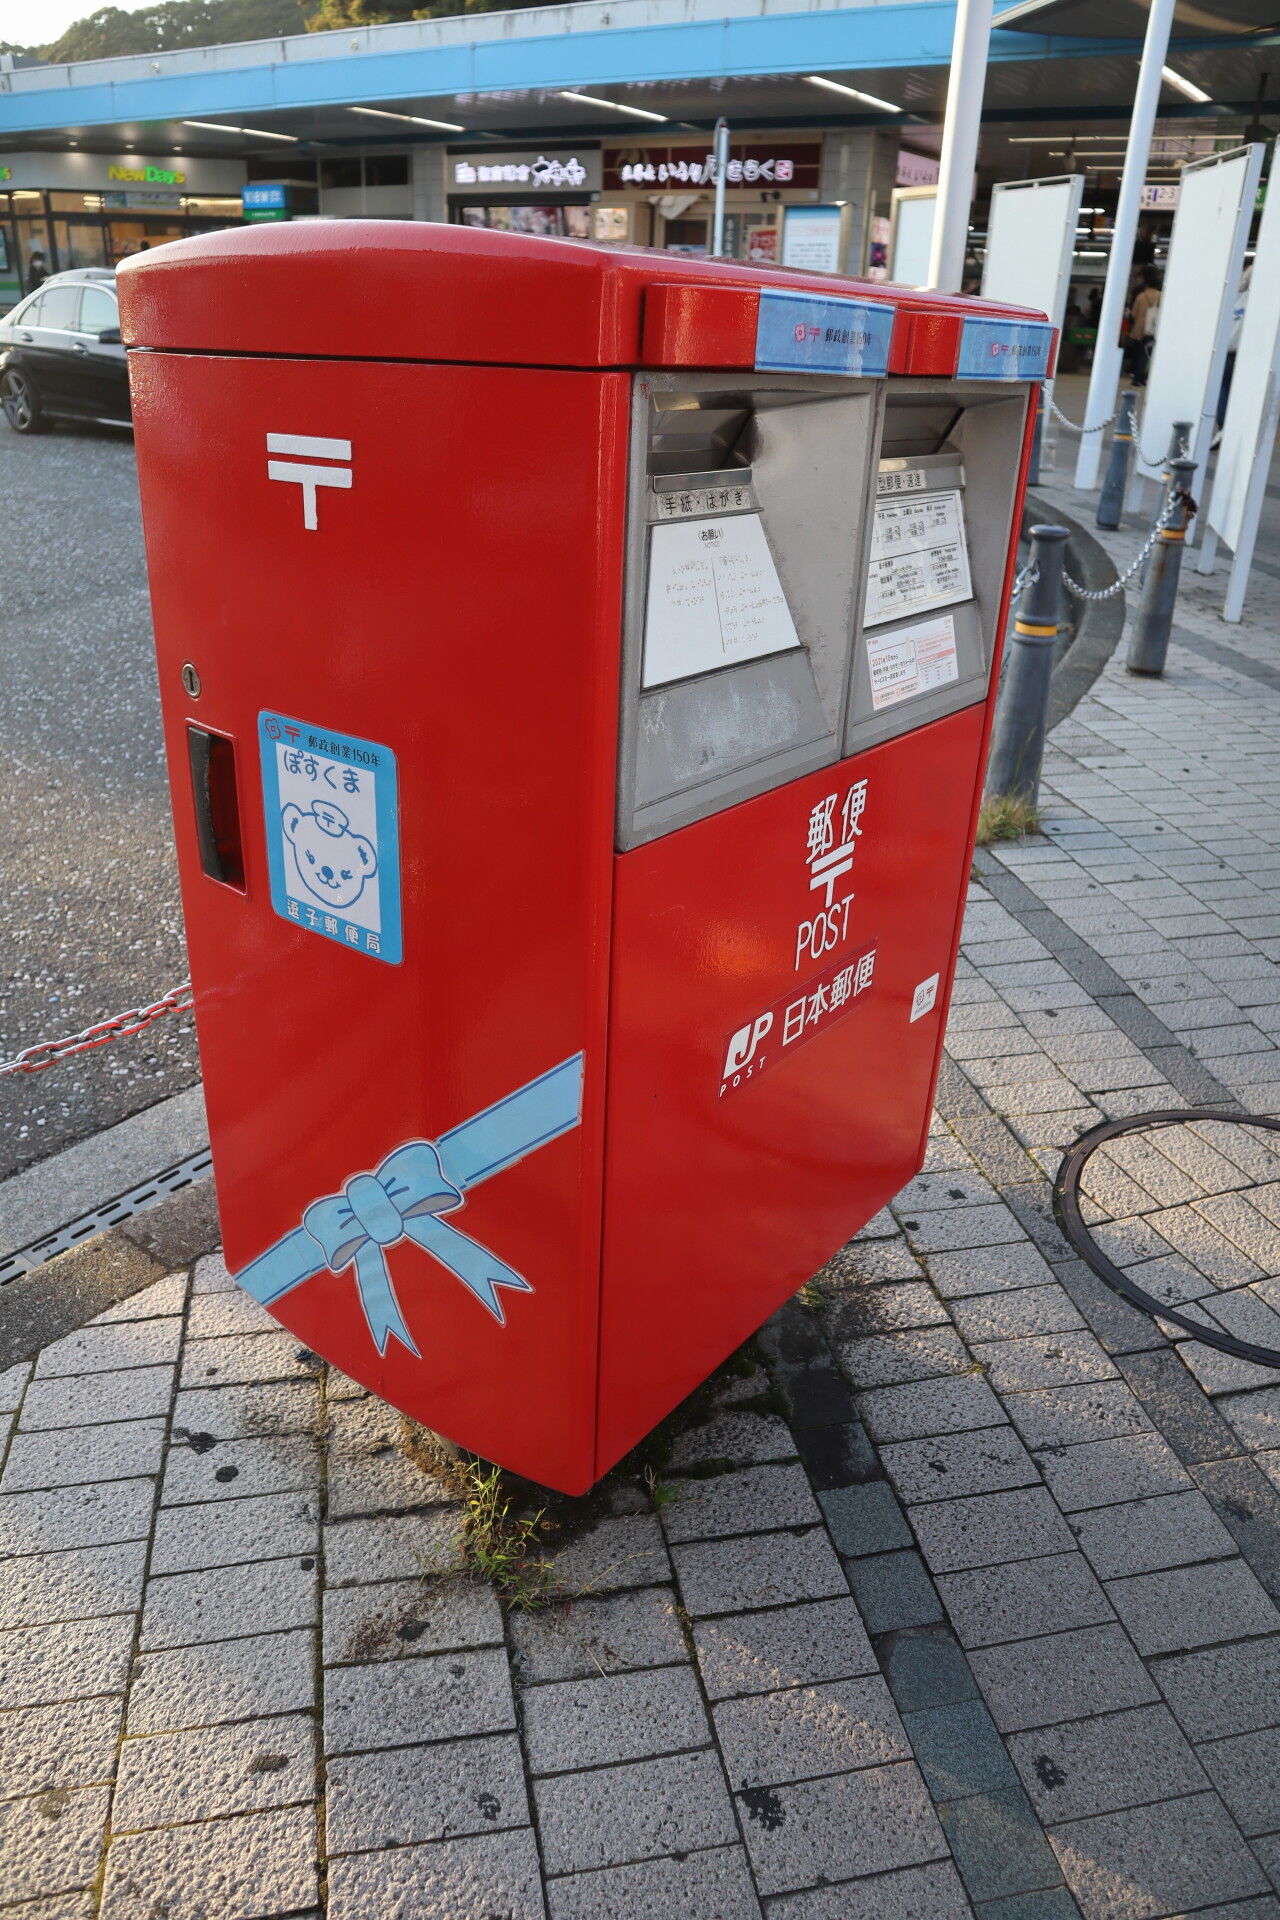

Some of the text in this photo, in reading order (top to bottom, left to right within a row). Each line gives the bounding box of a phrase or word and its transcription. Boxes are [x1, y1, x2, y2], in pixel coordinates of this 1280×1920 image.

[109, 166, 185, 184] NewDays
[665, 491, 743, 515] 手紙・はがき
[283, 750, 361, 793] ぽすくま
[307, 735, 381, 767] 郵政創業150年
[806, 778, 868, 864] 郵便
[287, 899, 381, 954] 逗子郵便局
[794, 893, 855, 972] POST
[782, 949, 876, 1047] 日本郵便
[720, 1056, 766, 1097] POST
